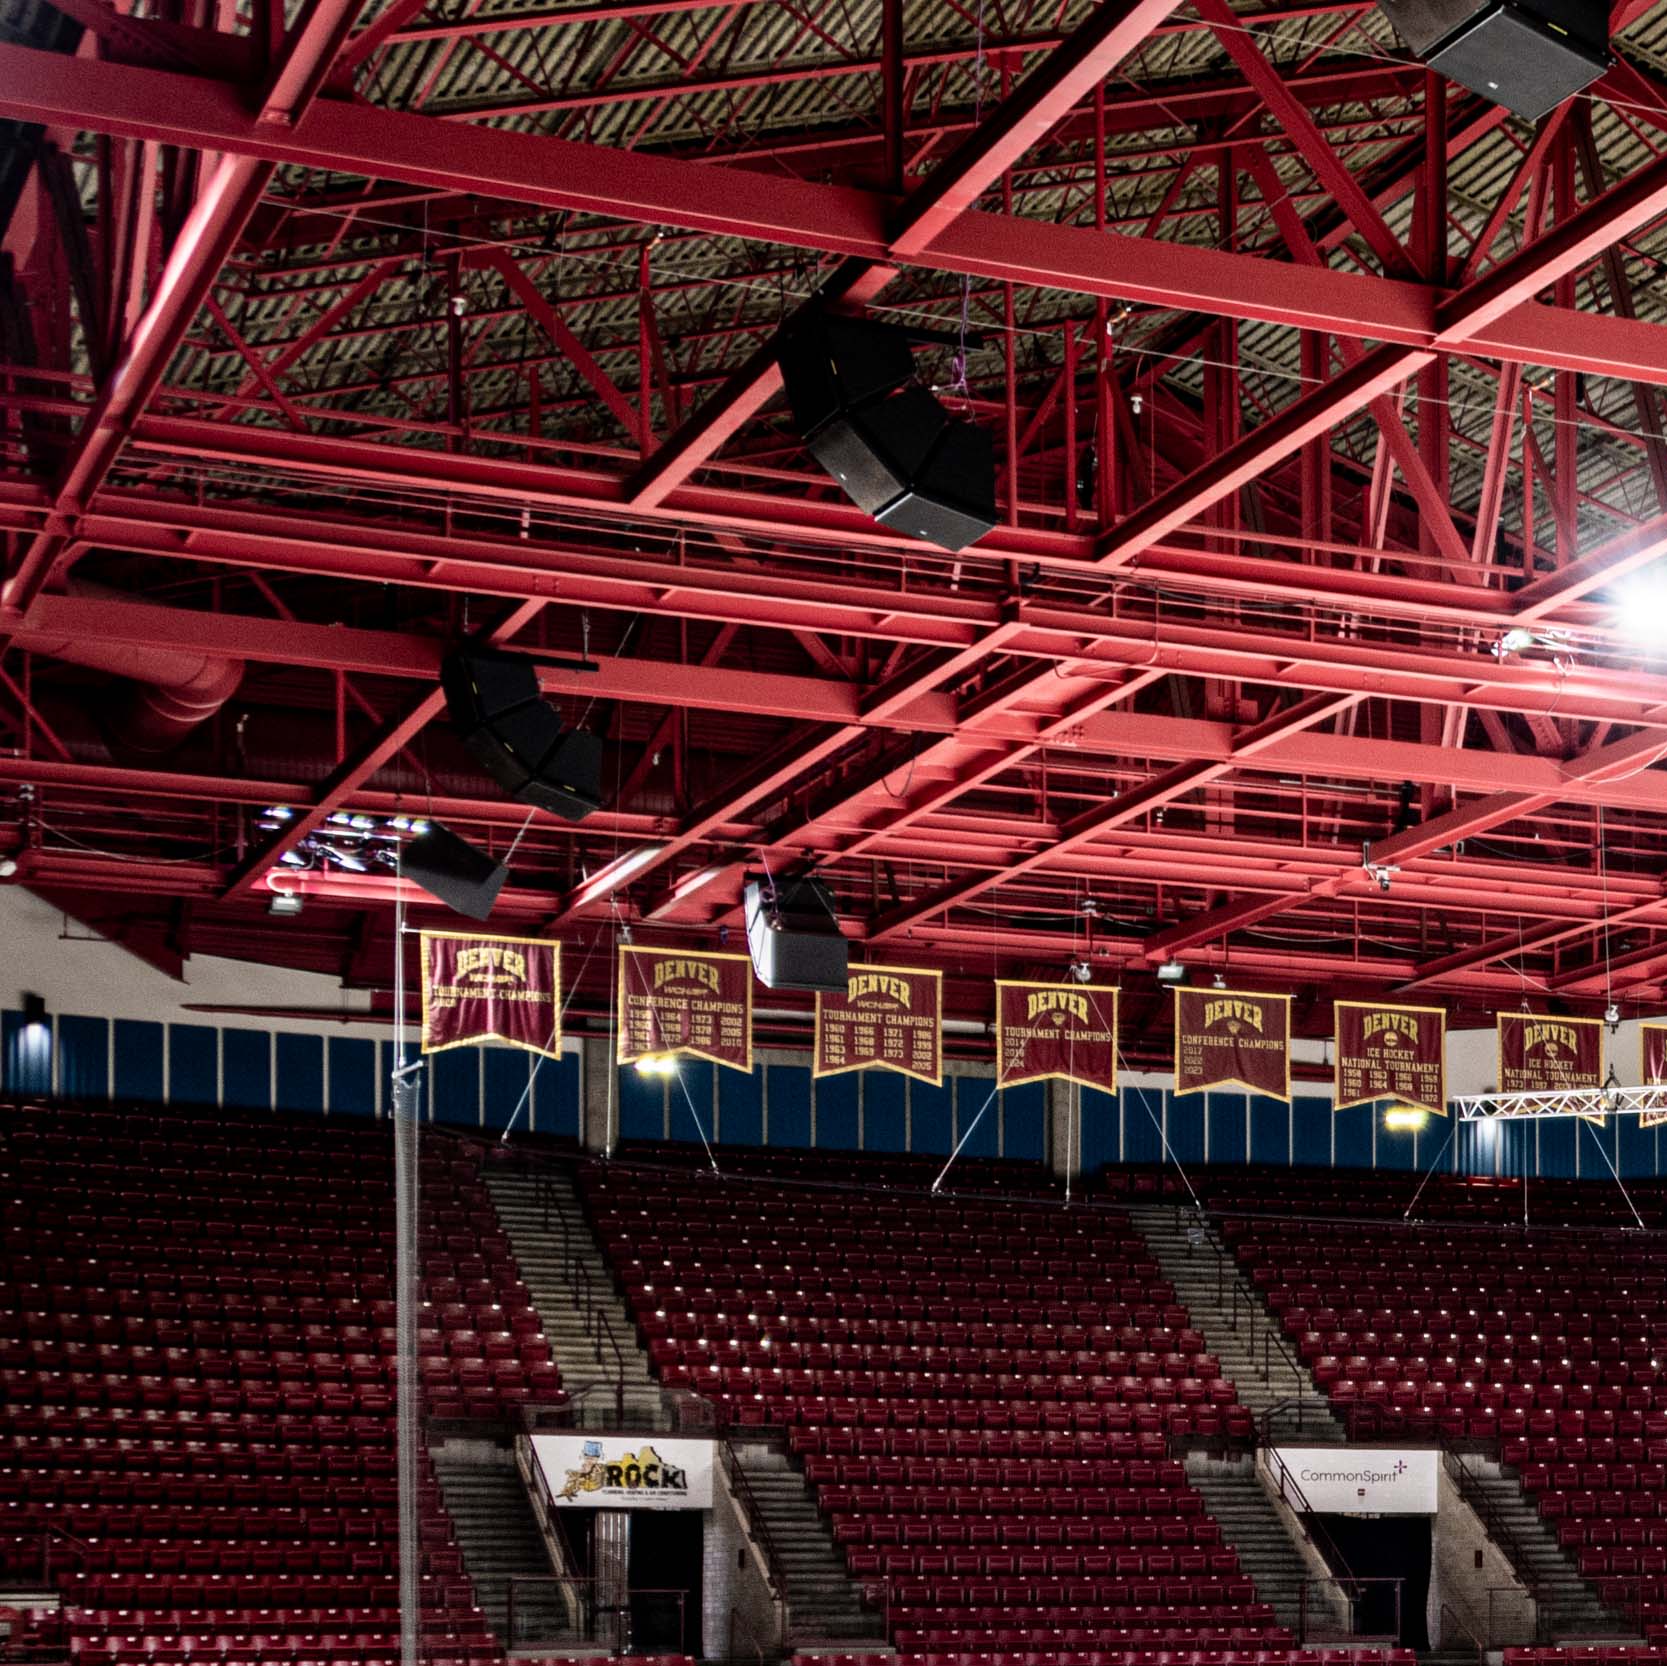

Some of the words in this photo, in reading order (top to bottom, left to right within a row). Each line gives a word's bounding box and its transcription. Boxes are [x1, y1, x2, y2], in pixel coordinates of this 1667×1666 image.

[456, 947, 527, 982] DENVER
[654, 959, 720, 995] DENVER
[848, 974, 911, 1010] DENVER
[628, 995, 689, 1010] CONFERENCE
[691, 1000, 744, 1014] CHAMPIONS
[1027, 991, 1089, 1025] DENVER
[823, 1009, 882, 1024] TOURNAMENT
[885, 1014, 935, 1028] CHAMPIONS
[1204, 999, 1263, 1033] DENVER
[1004, 1026, 1060, 1040] TOURNAMENT
[1064, 1030, 1111, 1042] CHAMPIONS
[1363, 1012, 1419, 1045] DENVER
[1182, 1034, 1235, 1047] CONFERENCE
[1239, 1038, 1285, 1051] CHAMPIONS
[1525, 1023, 1578, 1056] DENVER
[1367, 1047, 1380, 1058] ICE
[1383, 1048, 1415, 1060] HOCKEY
[1341, 1056, 1382, 1070] NATIONAL
[1385, 1060, 1440, 1073] TOURNAMENT
[1528, 1058, 1541, 1069] ICE
[1504, 1068, 1542, 1080] NATIONAL
[1545, 1070, 1597, 1083] TOURNAMENT
[1301, 1469, 1397, 1484] CommonSpirit
